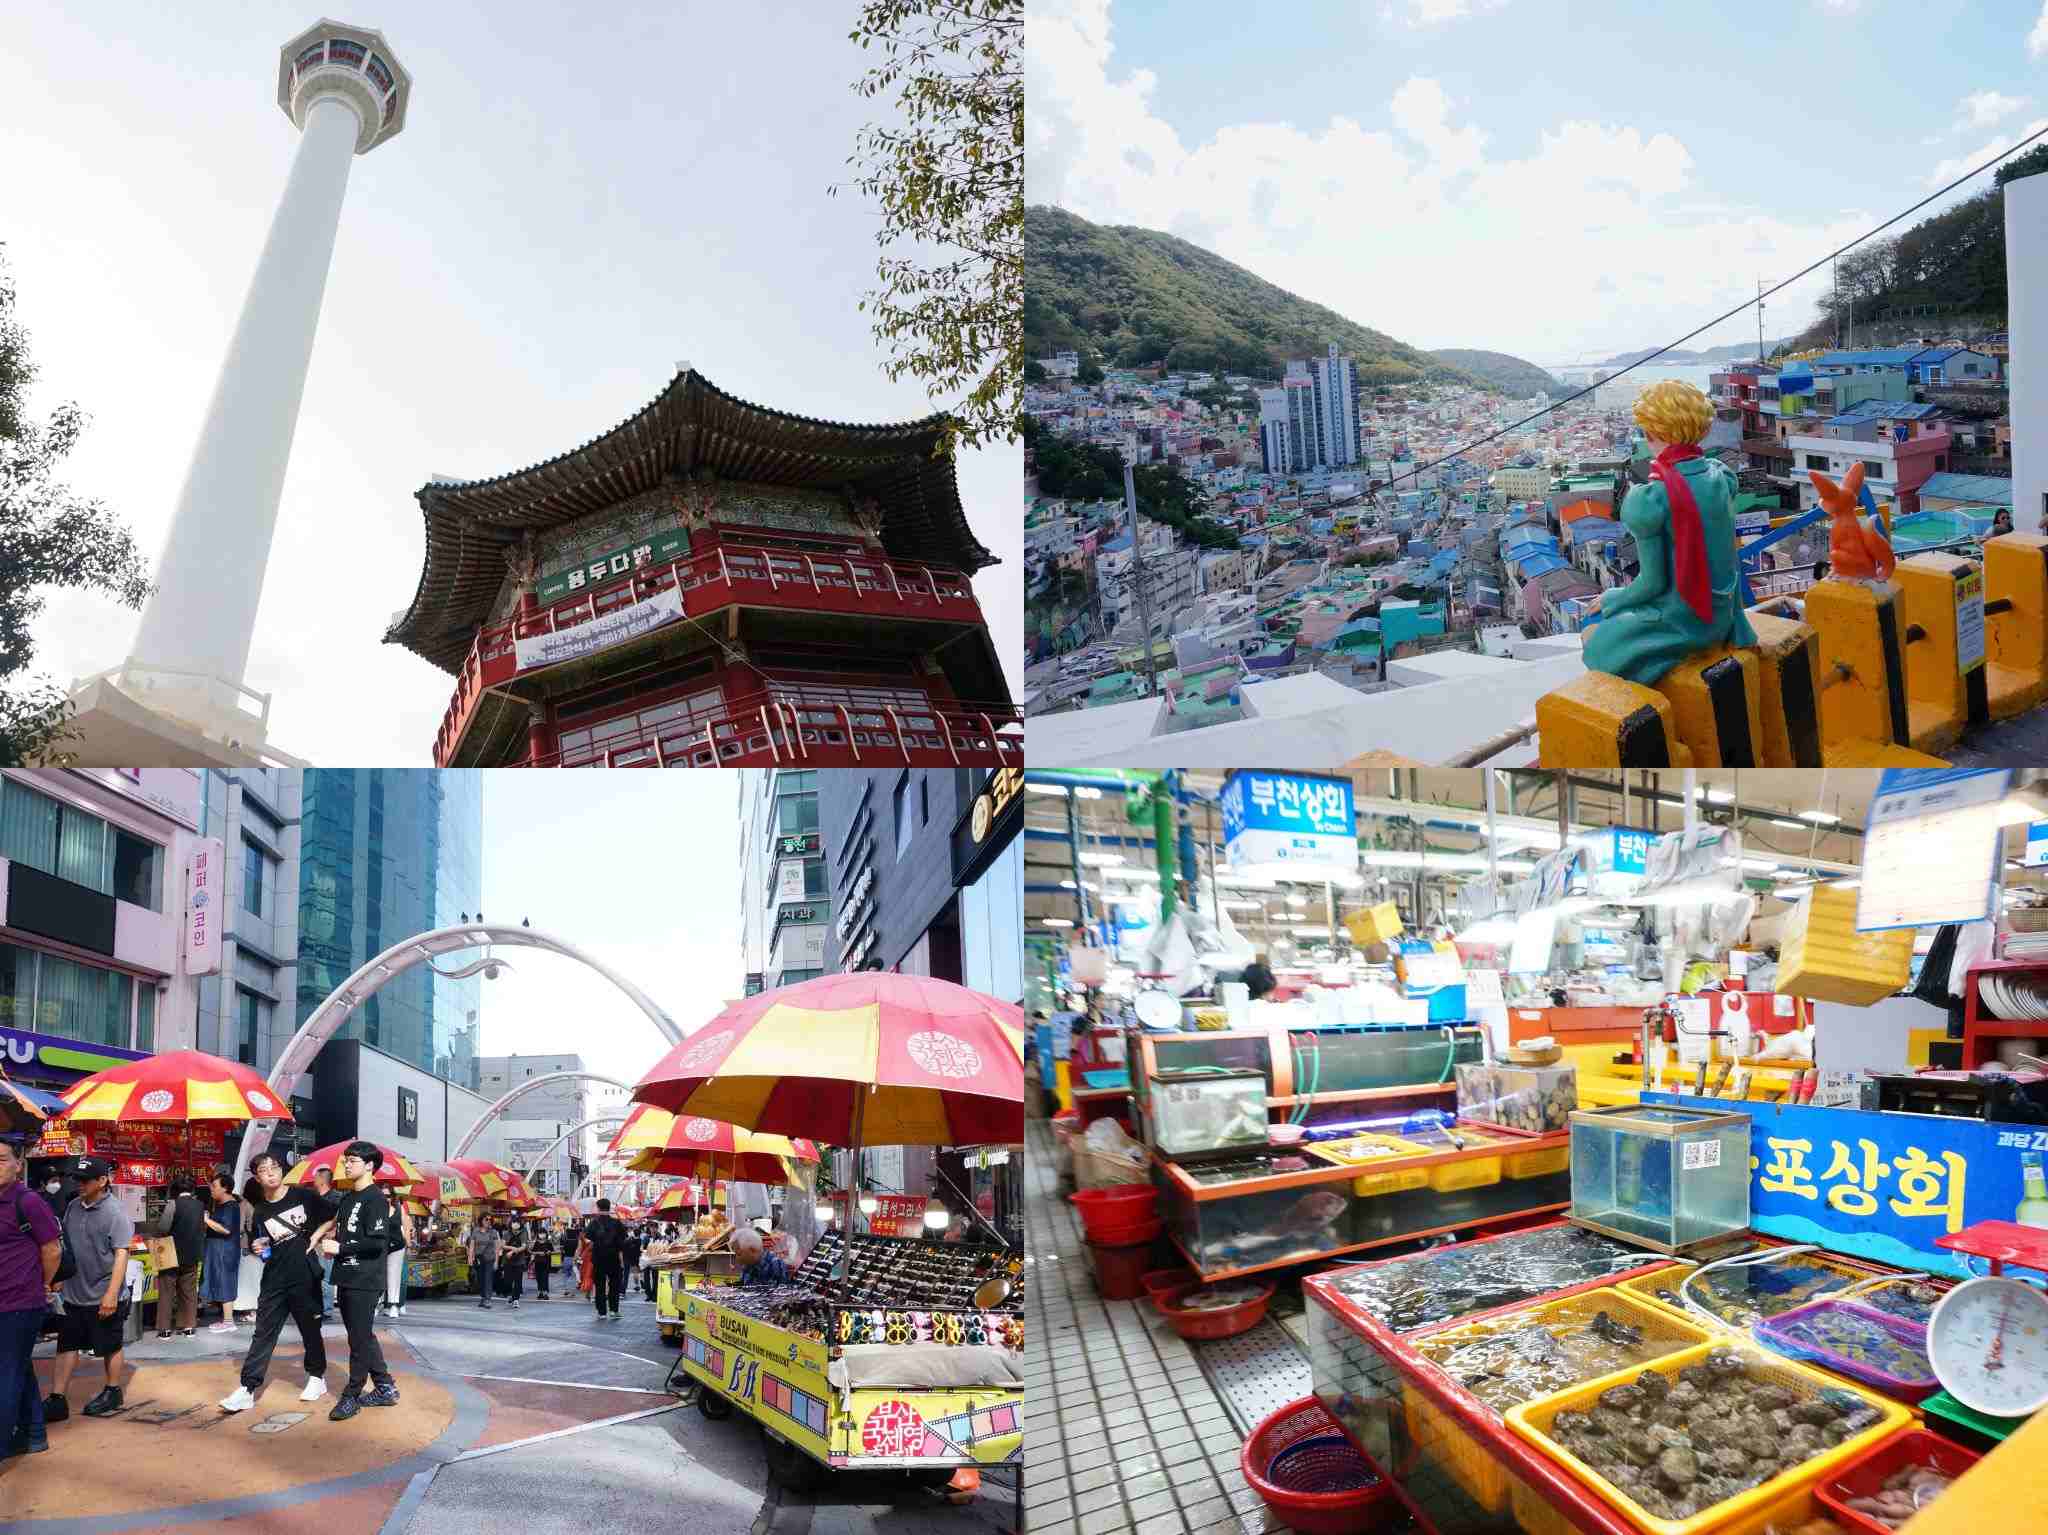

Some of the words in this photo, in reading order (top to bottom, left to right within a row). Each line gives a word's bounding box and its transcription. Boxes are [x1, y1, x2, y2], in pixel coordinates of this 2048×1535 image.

[1251, 777, 1347, 823] 부천상회
[0, 1035, 34, 1063] U
[1997, 1131, 2032, 1149] 과당
[1750, 1136, 1967, 1234] 포상회
[720, 1315, 749, 1338] BUSAN
